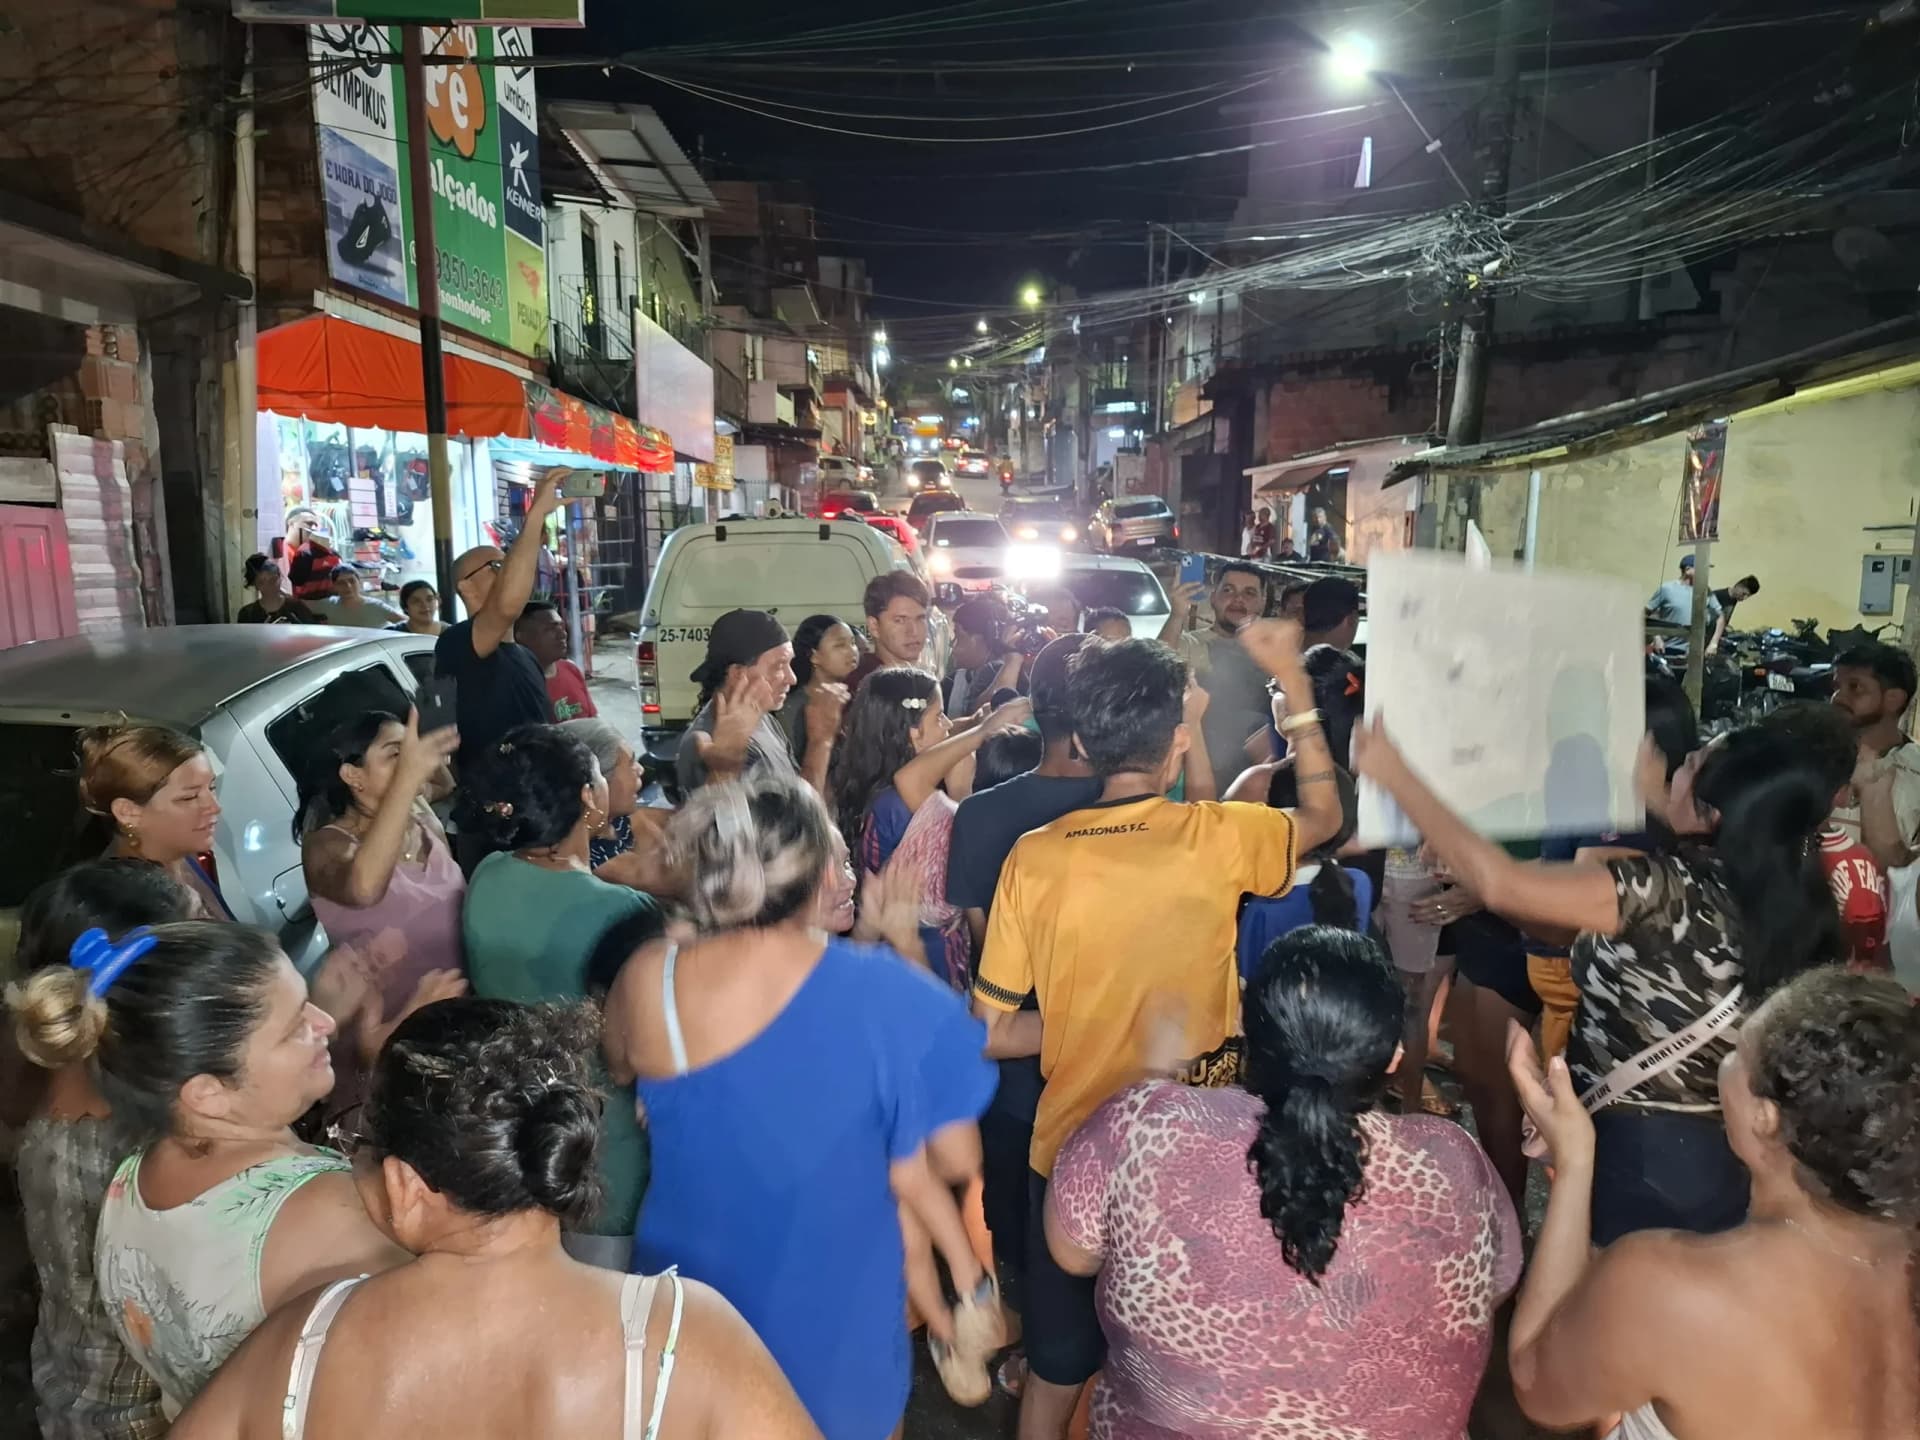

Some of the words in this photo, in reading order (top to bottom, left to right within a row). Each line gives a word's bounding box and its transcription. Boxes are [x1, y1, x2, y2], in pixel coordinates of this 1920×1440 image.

[321, 50, 387, 130] OLYMPIKUS
[503, 80, 532, 121] umbro
[430, 158, 497, 229] alçados
[506, 186, 542, 223] KENNER
[438, 286, 493, 327] sonhodope
[660, 628, 711, 642] 25-7403
[1064, 824, 1127, 840] AMAZONAS
[1637, 1046, 1673, 1071] WORRY
[1673, 1033, 1698, 1051] LESS
